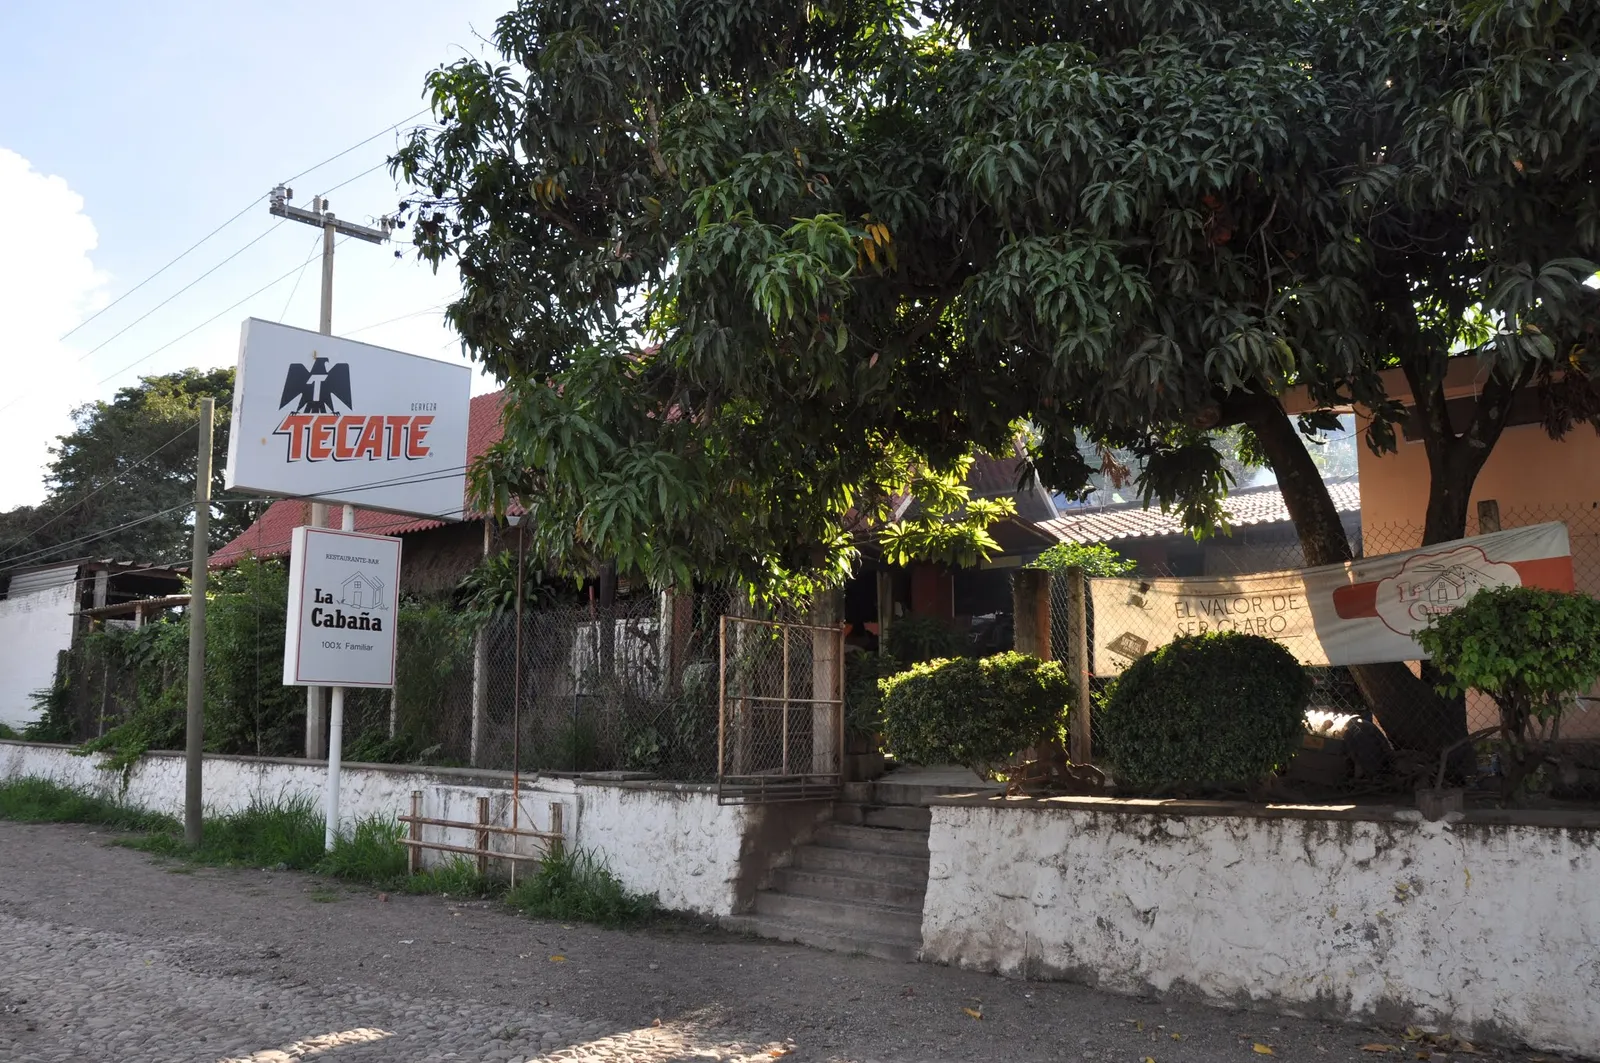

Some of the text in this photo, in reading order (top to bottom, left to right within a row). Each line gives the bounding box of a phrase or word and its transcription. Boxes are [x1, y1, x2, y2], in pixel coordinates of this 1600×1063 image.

[411, 402, 437, 412] CERVEZA
[273, 415, 436, 463] TECATE
[325, 553, 380, 565] RESTAURANTE-BAR
[314, 588, 334, 604] La
[1174, 594, 1301, 619] EL VALOR DE
[311, 607, 383, 632] Cabaña
[321, 641, 374, 651] 100% Familiar
